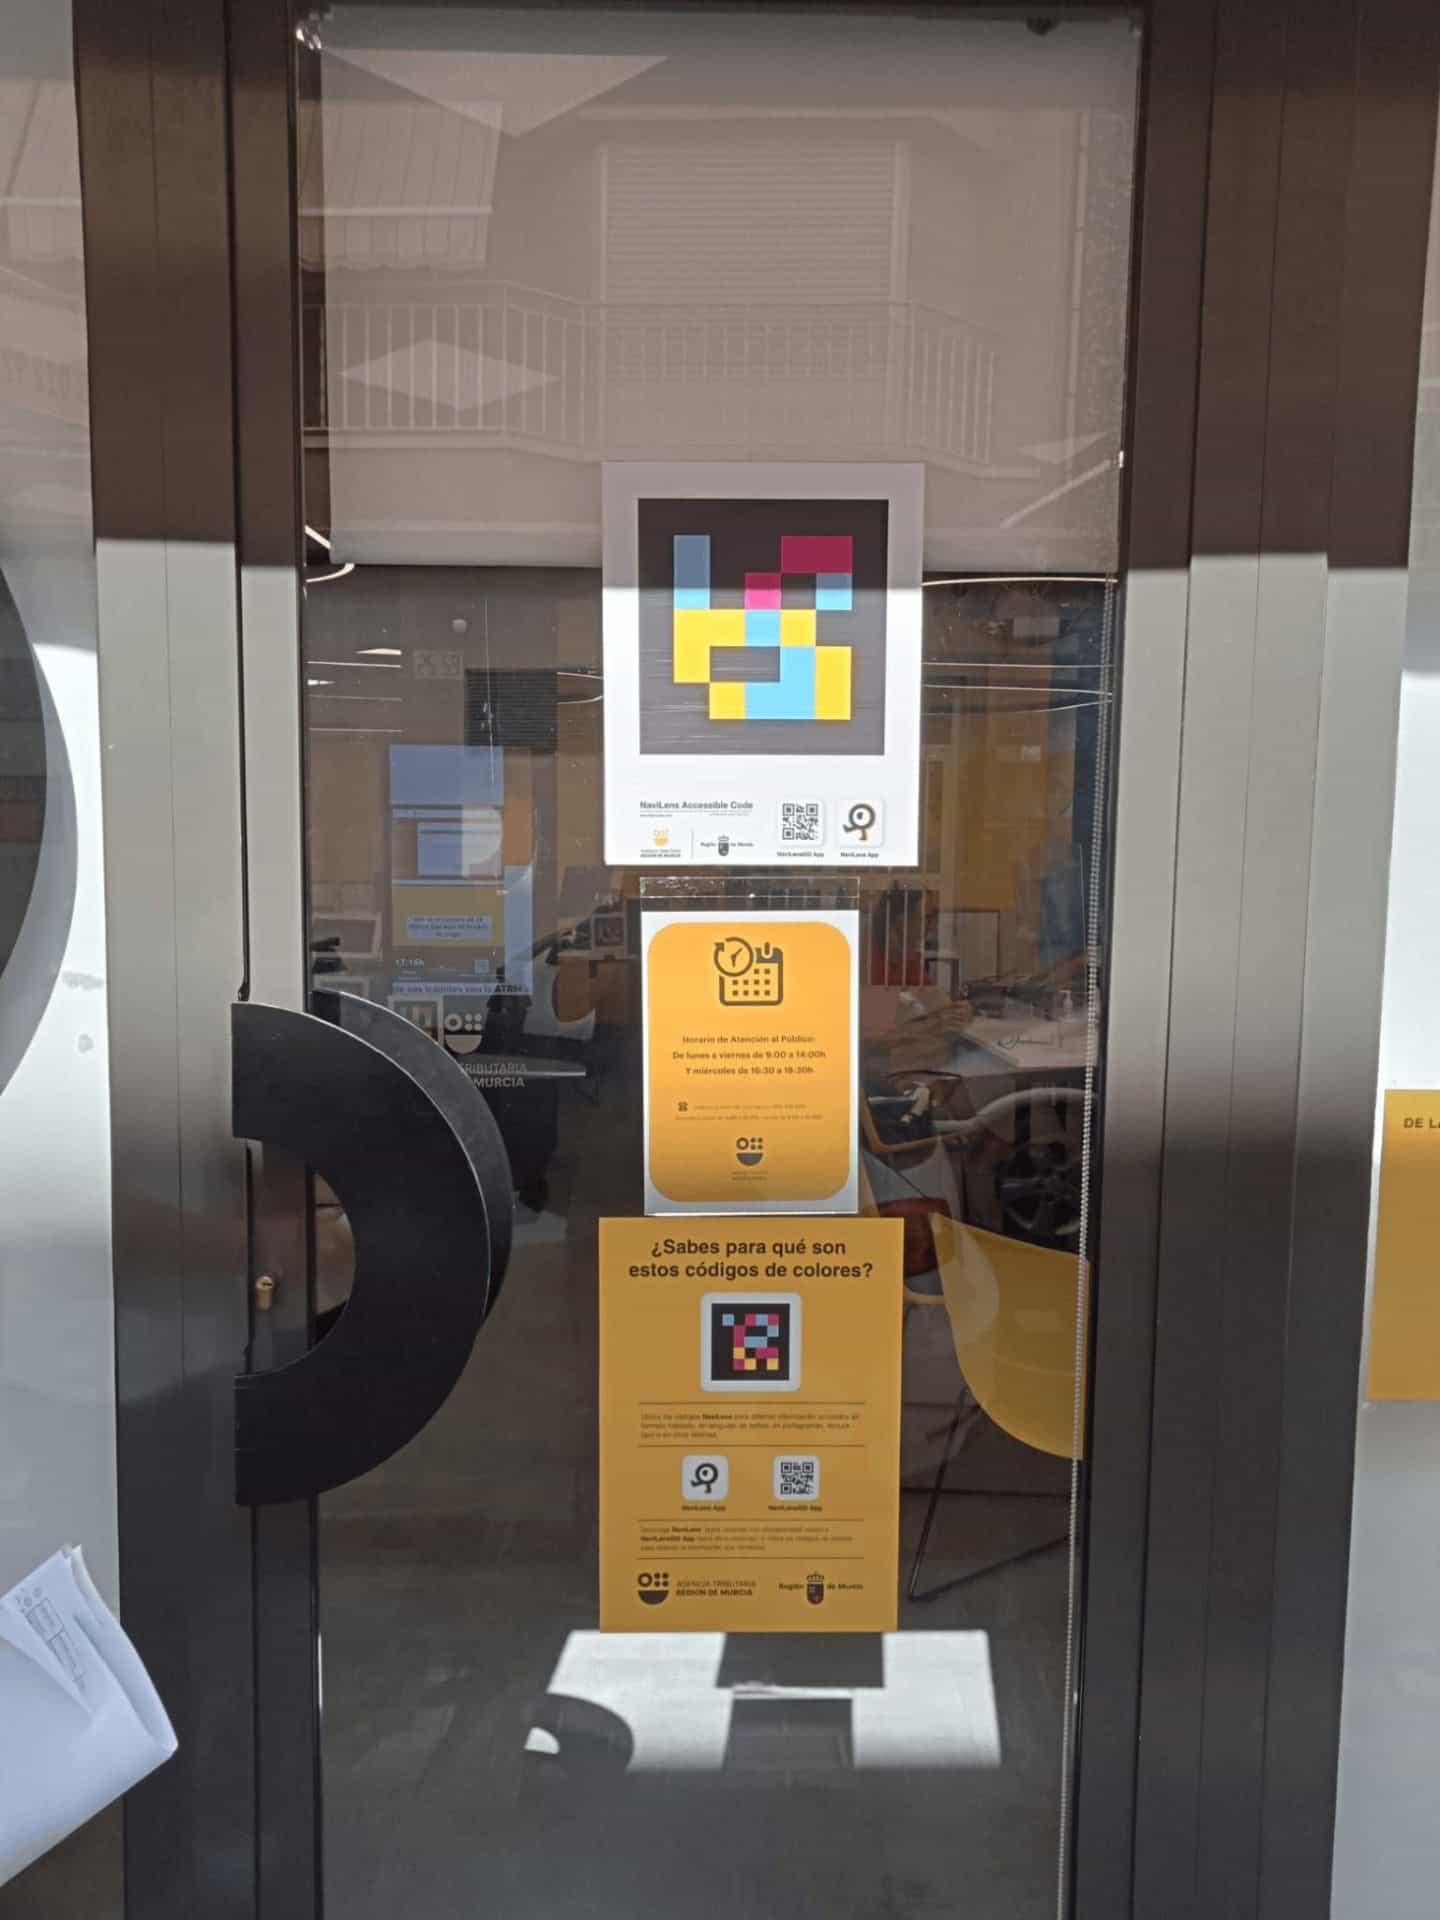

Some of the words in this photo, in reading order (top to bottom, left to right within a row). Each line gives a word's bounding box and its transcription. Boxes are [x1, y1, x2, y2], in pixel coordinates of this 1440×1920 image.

[640, 800, 680, 809] NaviLens
[682, 800, 728, 809] Accessible
[730, 800, 753, 809] Code
[682, 1034, 715, 1044] Horario
[717, 1034, 729, 1044] de
[731, 1033, 769, 1044] Atención
[771, 1034, 779, 1044] al
[672, 1051, 684, 1059] De
[686, 1050, 710, 1059] lunes
[719, 1051, 750, 1059] viernes
[752, 1049, 763, 1059] de
[685, 1067, 691, 1075] Y
[693, 1066, 736, 1075] miércoles
[738, 1066, 749, 1075] de
[473, 1076, 525, 1088] MURCIA
[1403, 1117, 1425, 1129] DE
[651, 1238, 720, 1257] ¿Sabes
[725, 1242, 767, 1258] para
[772, 1239, 807, 1258] qué
[812, 1242, 846, 1255] son
[628, 1264, 680, 1278] estos
[685, 1261, 760, 1281] códigos
[765, 1262, 788, 1278] de
[792, 1262, 874, 1278] colores?
